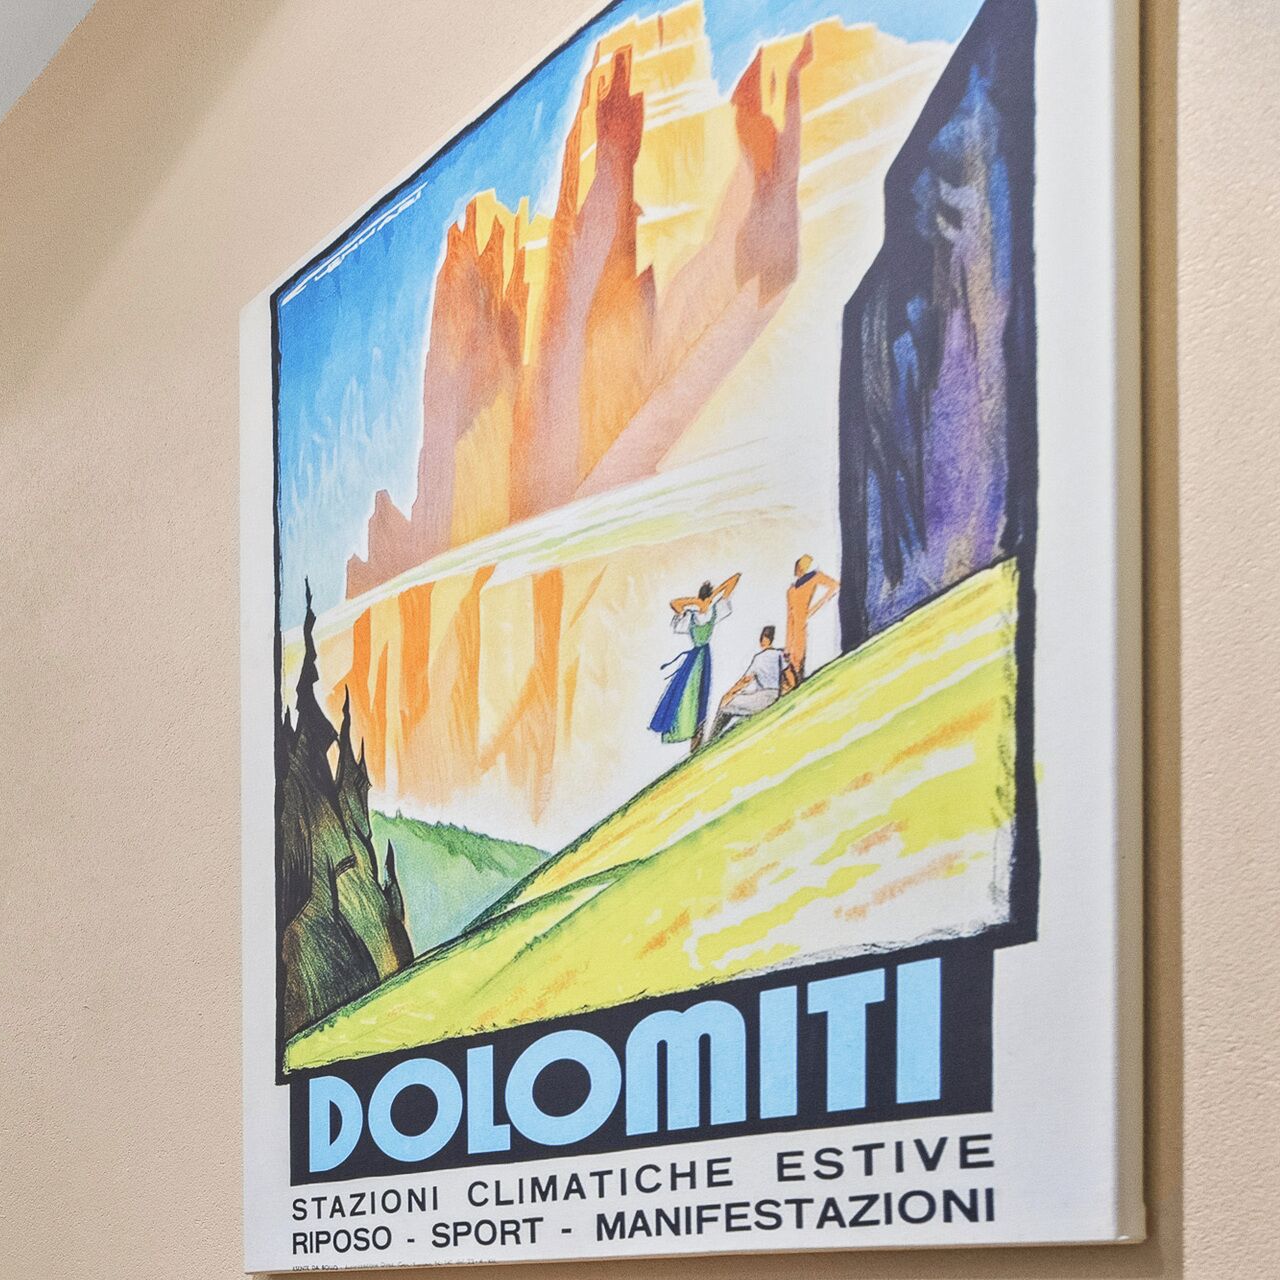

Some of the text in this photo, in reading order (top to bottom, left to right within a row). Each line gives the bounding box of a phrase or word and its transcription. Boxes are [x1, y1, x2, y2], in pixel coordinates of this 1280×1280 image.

[309, 957, 941, 1173] DOLOMITI
[291, 1133, 995, 1222] STAZIONI CLIMATICHE ESTIVE
[291, 1228, 392, 1256] RIPOSO
[430, 1217, 544, 1249] SPORT
[595, 1186, 996, 1242] MANIFESTAZIONI
